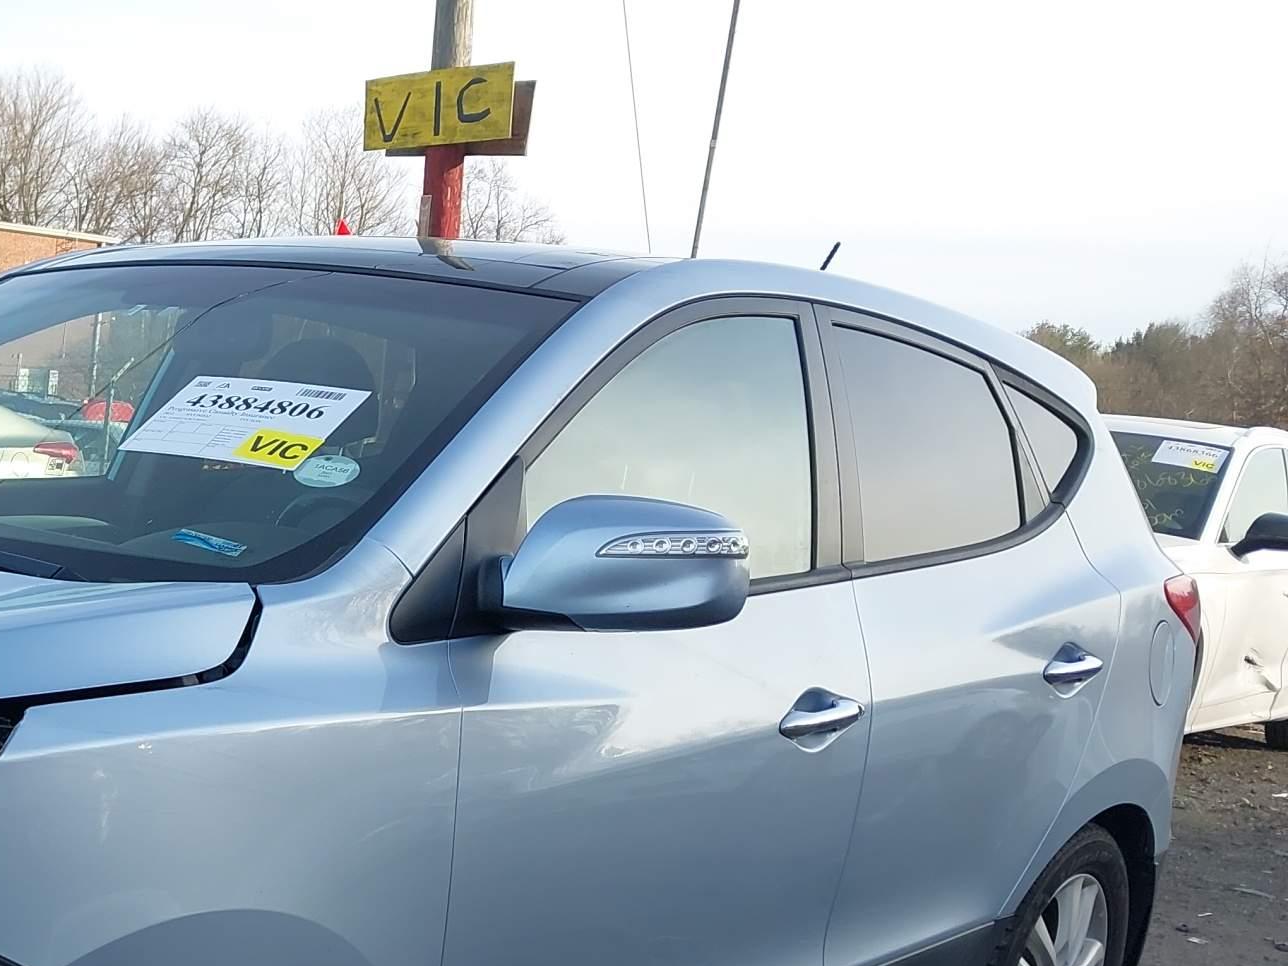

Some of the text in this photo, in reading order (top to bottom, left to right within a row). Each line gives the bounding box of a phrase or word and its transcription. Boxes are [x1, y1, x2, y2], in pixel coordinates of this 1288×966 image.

[373, 77, 491, 143] VIC
[185, 392, 331, 420] 43884806
[249, 435, 308, 460] VIC
[1193, 460, 1215, 470] VIC
